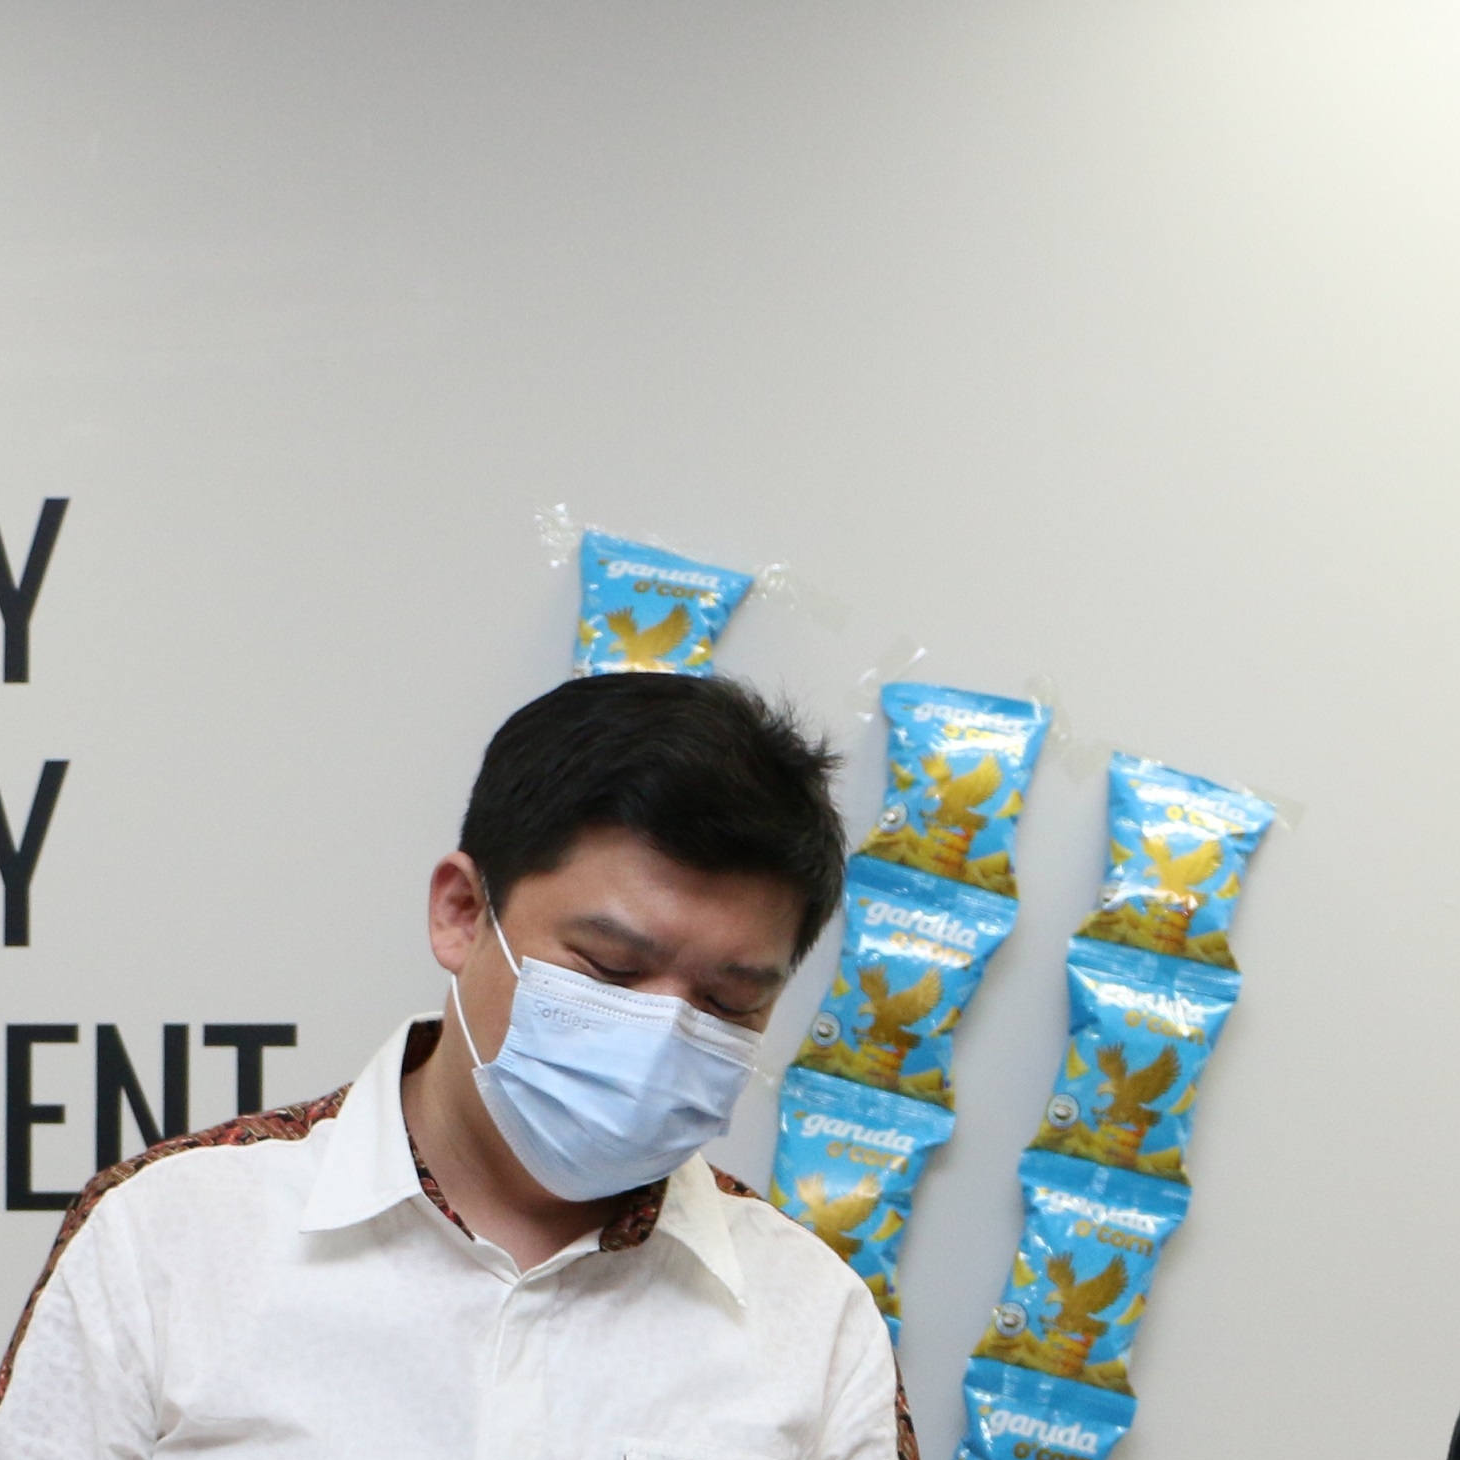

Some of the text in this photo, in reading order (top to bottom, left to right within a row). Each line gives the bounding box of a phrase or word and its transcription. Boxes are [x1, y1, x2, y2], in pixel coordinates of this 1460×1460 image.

[605, 560, 720, 590] garuda
[864, 902, 979, 949] garuda
[1123, 1010, 1206, 1047] o'corn
[801, 1113, 916, 1155] garuda
[826, 1141, 910, 1175] o'corn
[1043, 1190, 1158, 1235] garuda
[1074, 1219, 1155, 1257] o'corn
[990, 1409, 1099, 1455] garuda
